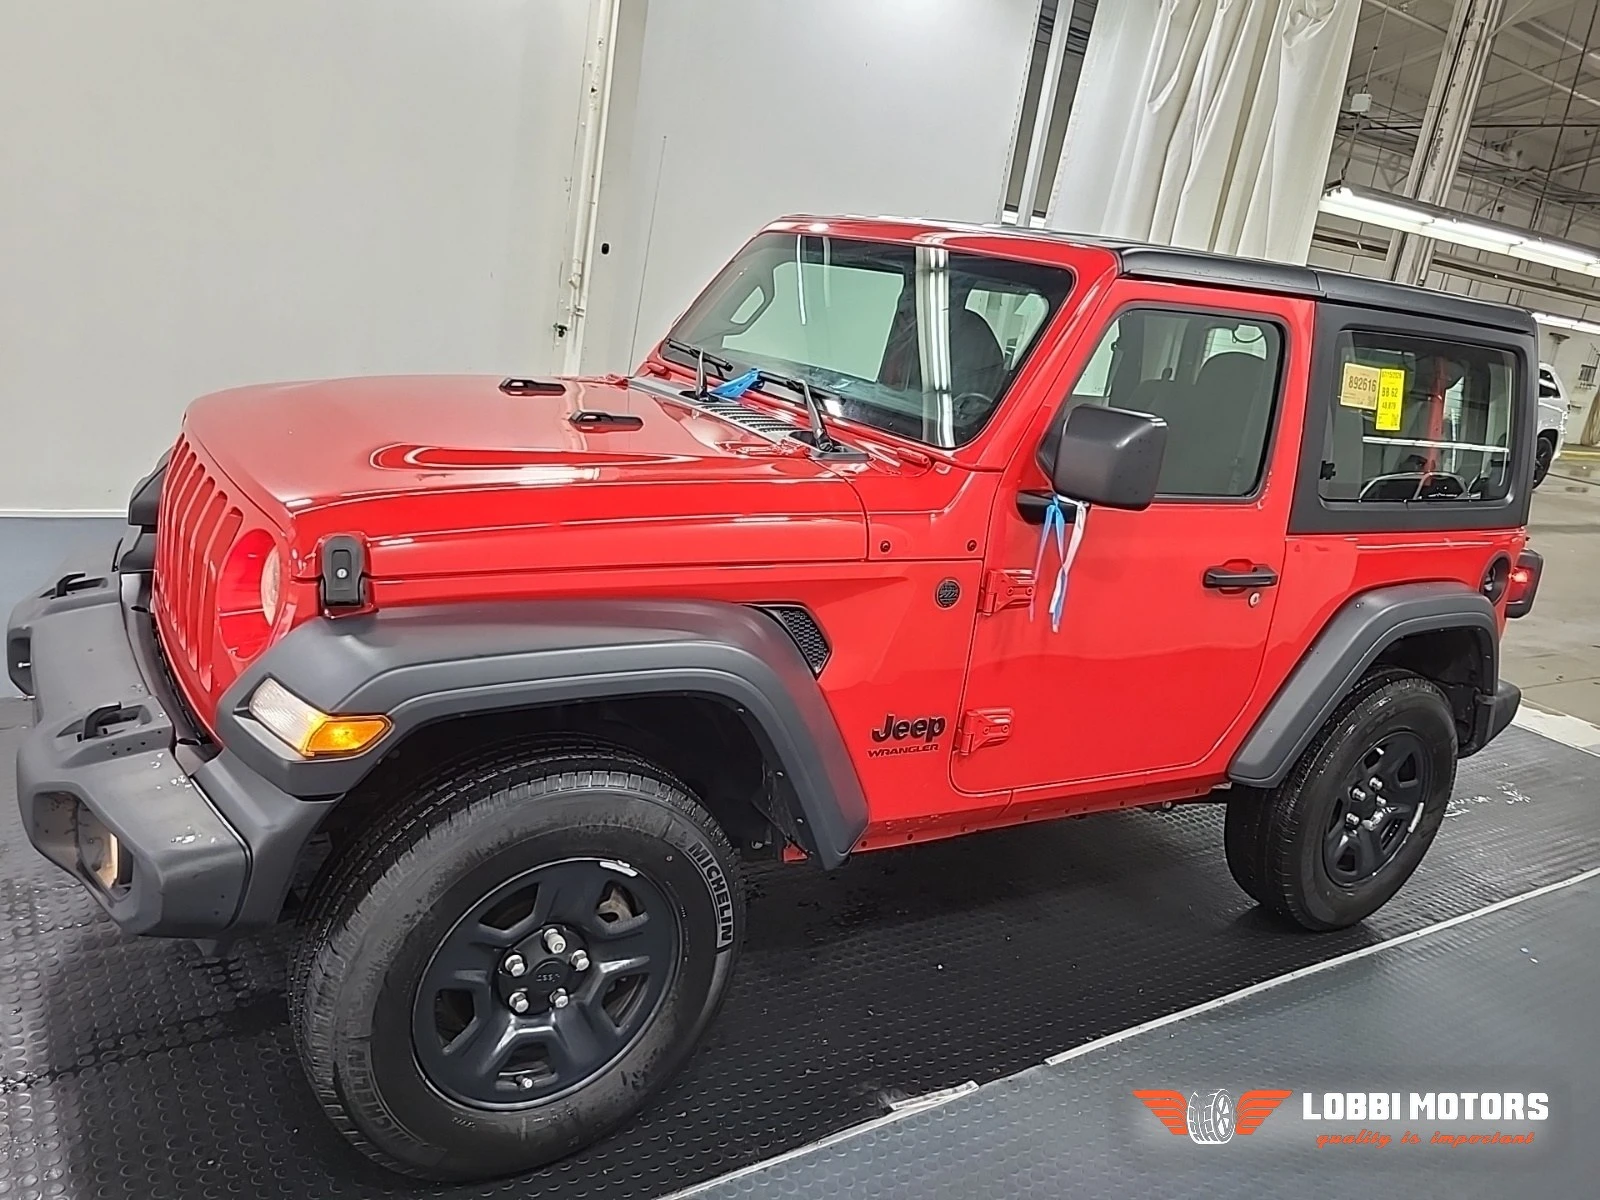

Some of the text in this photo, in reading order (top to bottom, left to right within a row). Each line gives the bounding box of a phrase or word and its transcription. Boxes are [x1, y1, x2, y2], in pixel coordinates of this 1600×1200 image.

[1348, 375, 1377, 392] 892616
[1391, 387, 1399, 397] 62
[871, 713, 946, 743] Jeep
[867, 743, 939, 758] WRANGLER
[686, 840, 733, 942] MICHELIN
